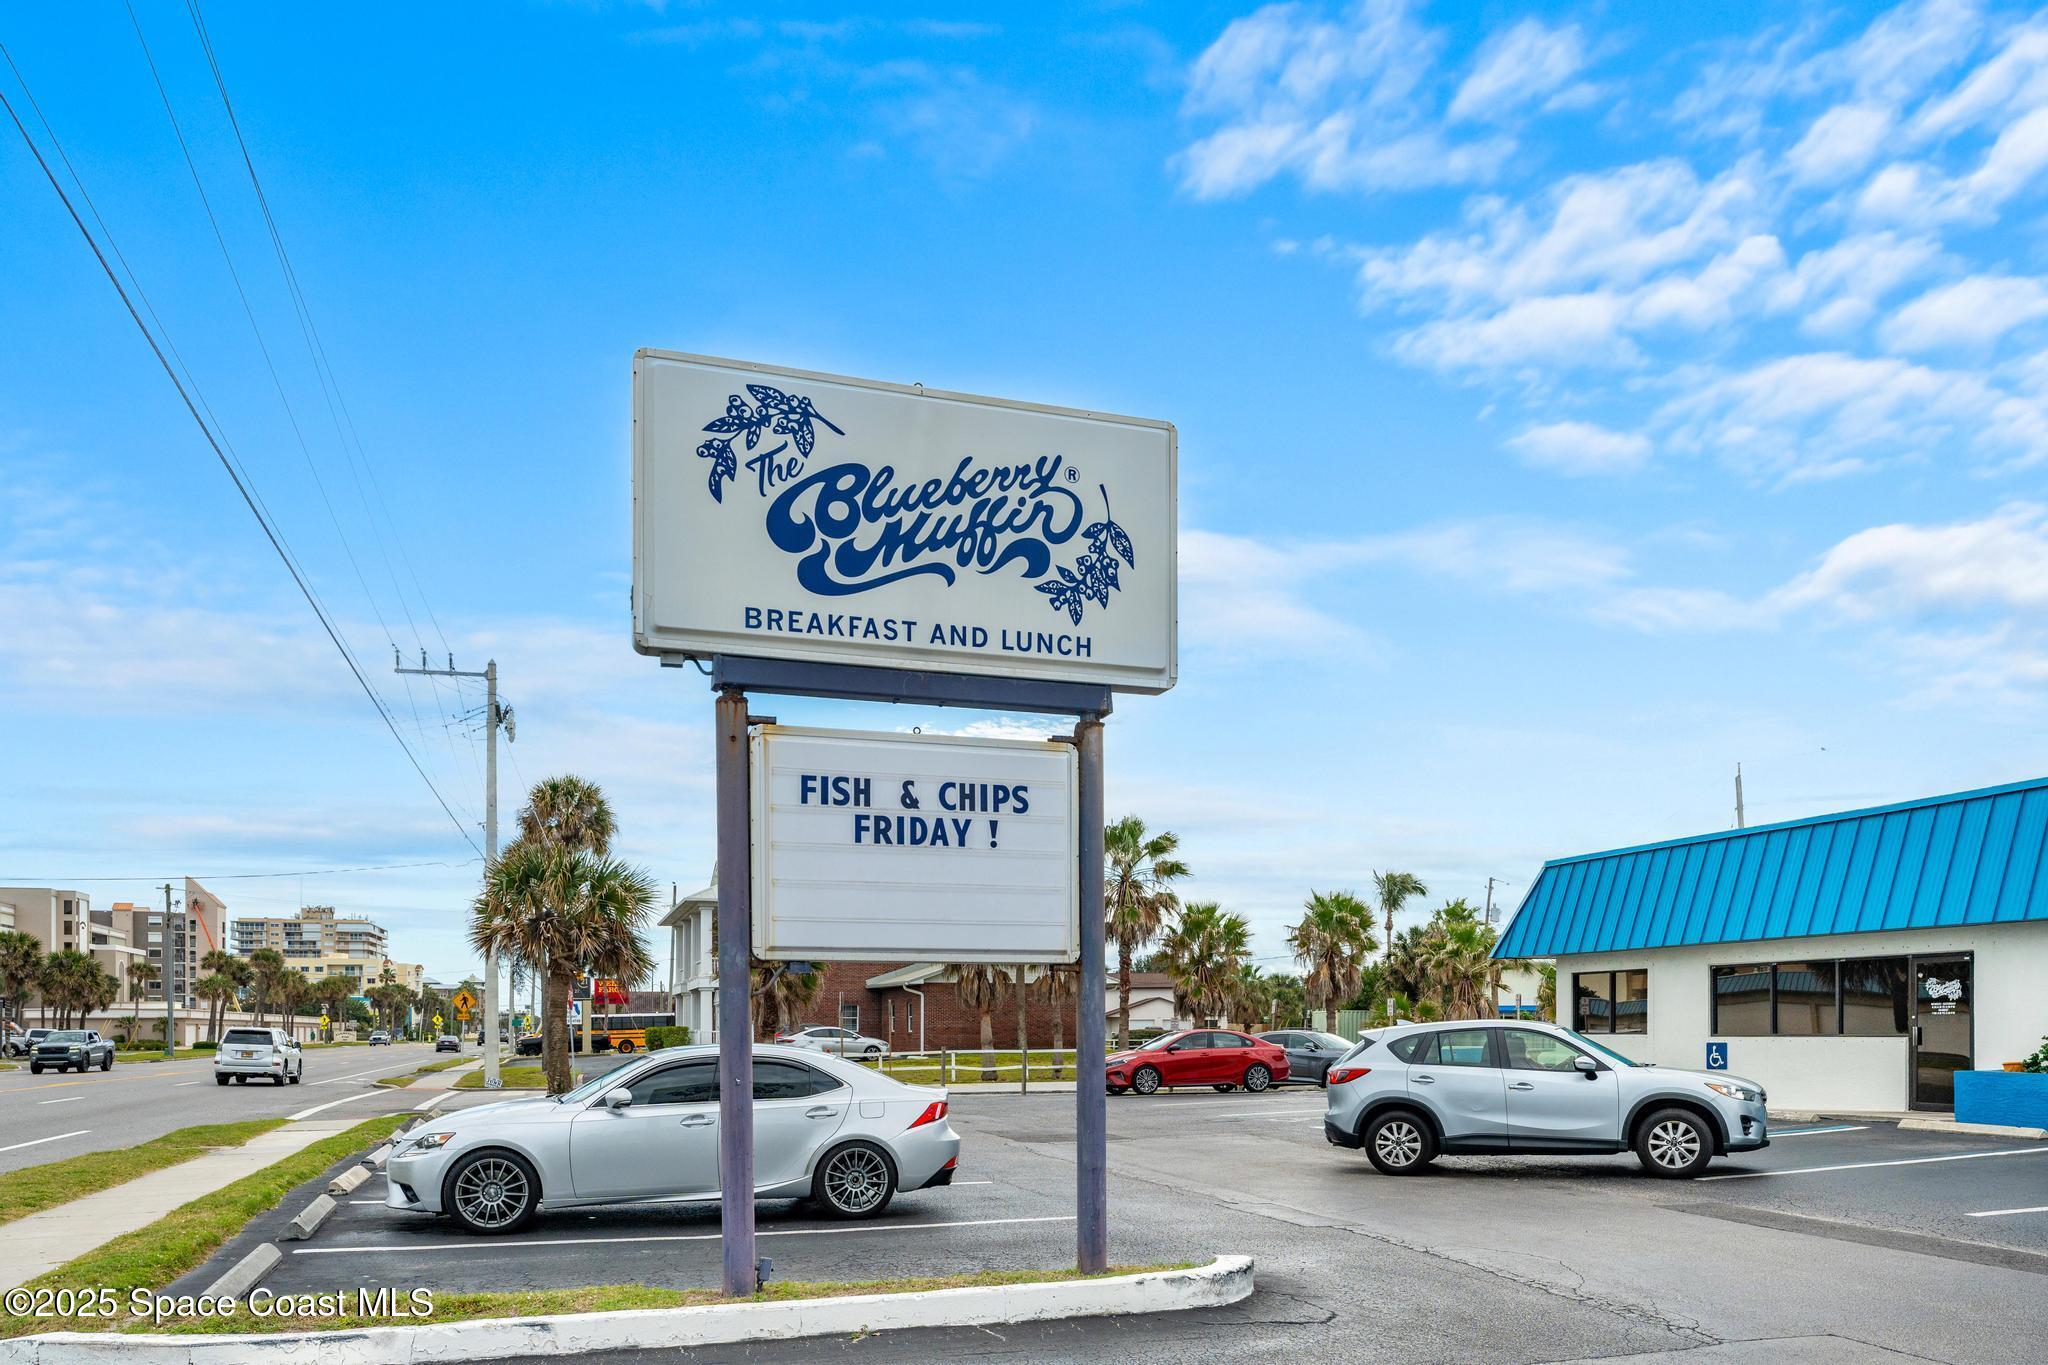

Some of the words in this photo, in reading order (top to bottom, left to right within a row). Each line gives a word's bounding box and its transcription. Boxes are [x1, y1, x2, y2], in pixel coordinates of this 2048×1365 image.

[745, 440, 804, 497] The
[766, 454, 1062, 553] Blueberry
[835, 495, 1083, 577] Muffin
[745, 606, 917, 642] BREAKFAST
[929, 624, 988, 649] AND
[1001, 634, 1092, 658] LUNCH
[800, 774, 871, 807] FISH
[900, 779, 920, 810] &
[938, 781, 1029, 814] CHIPS
[854, 814, 972, 848] FRIDAY
